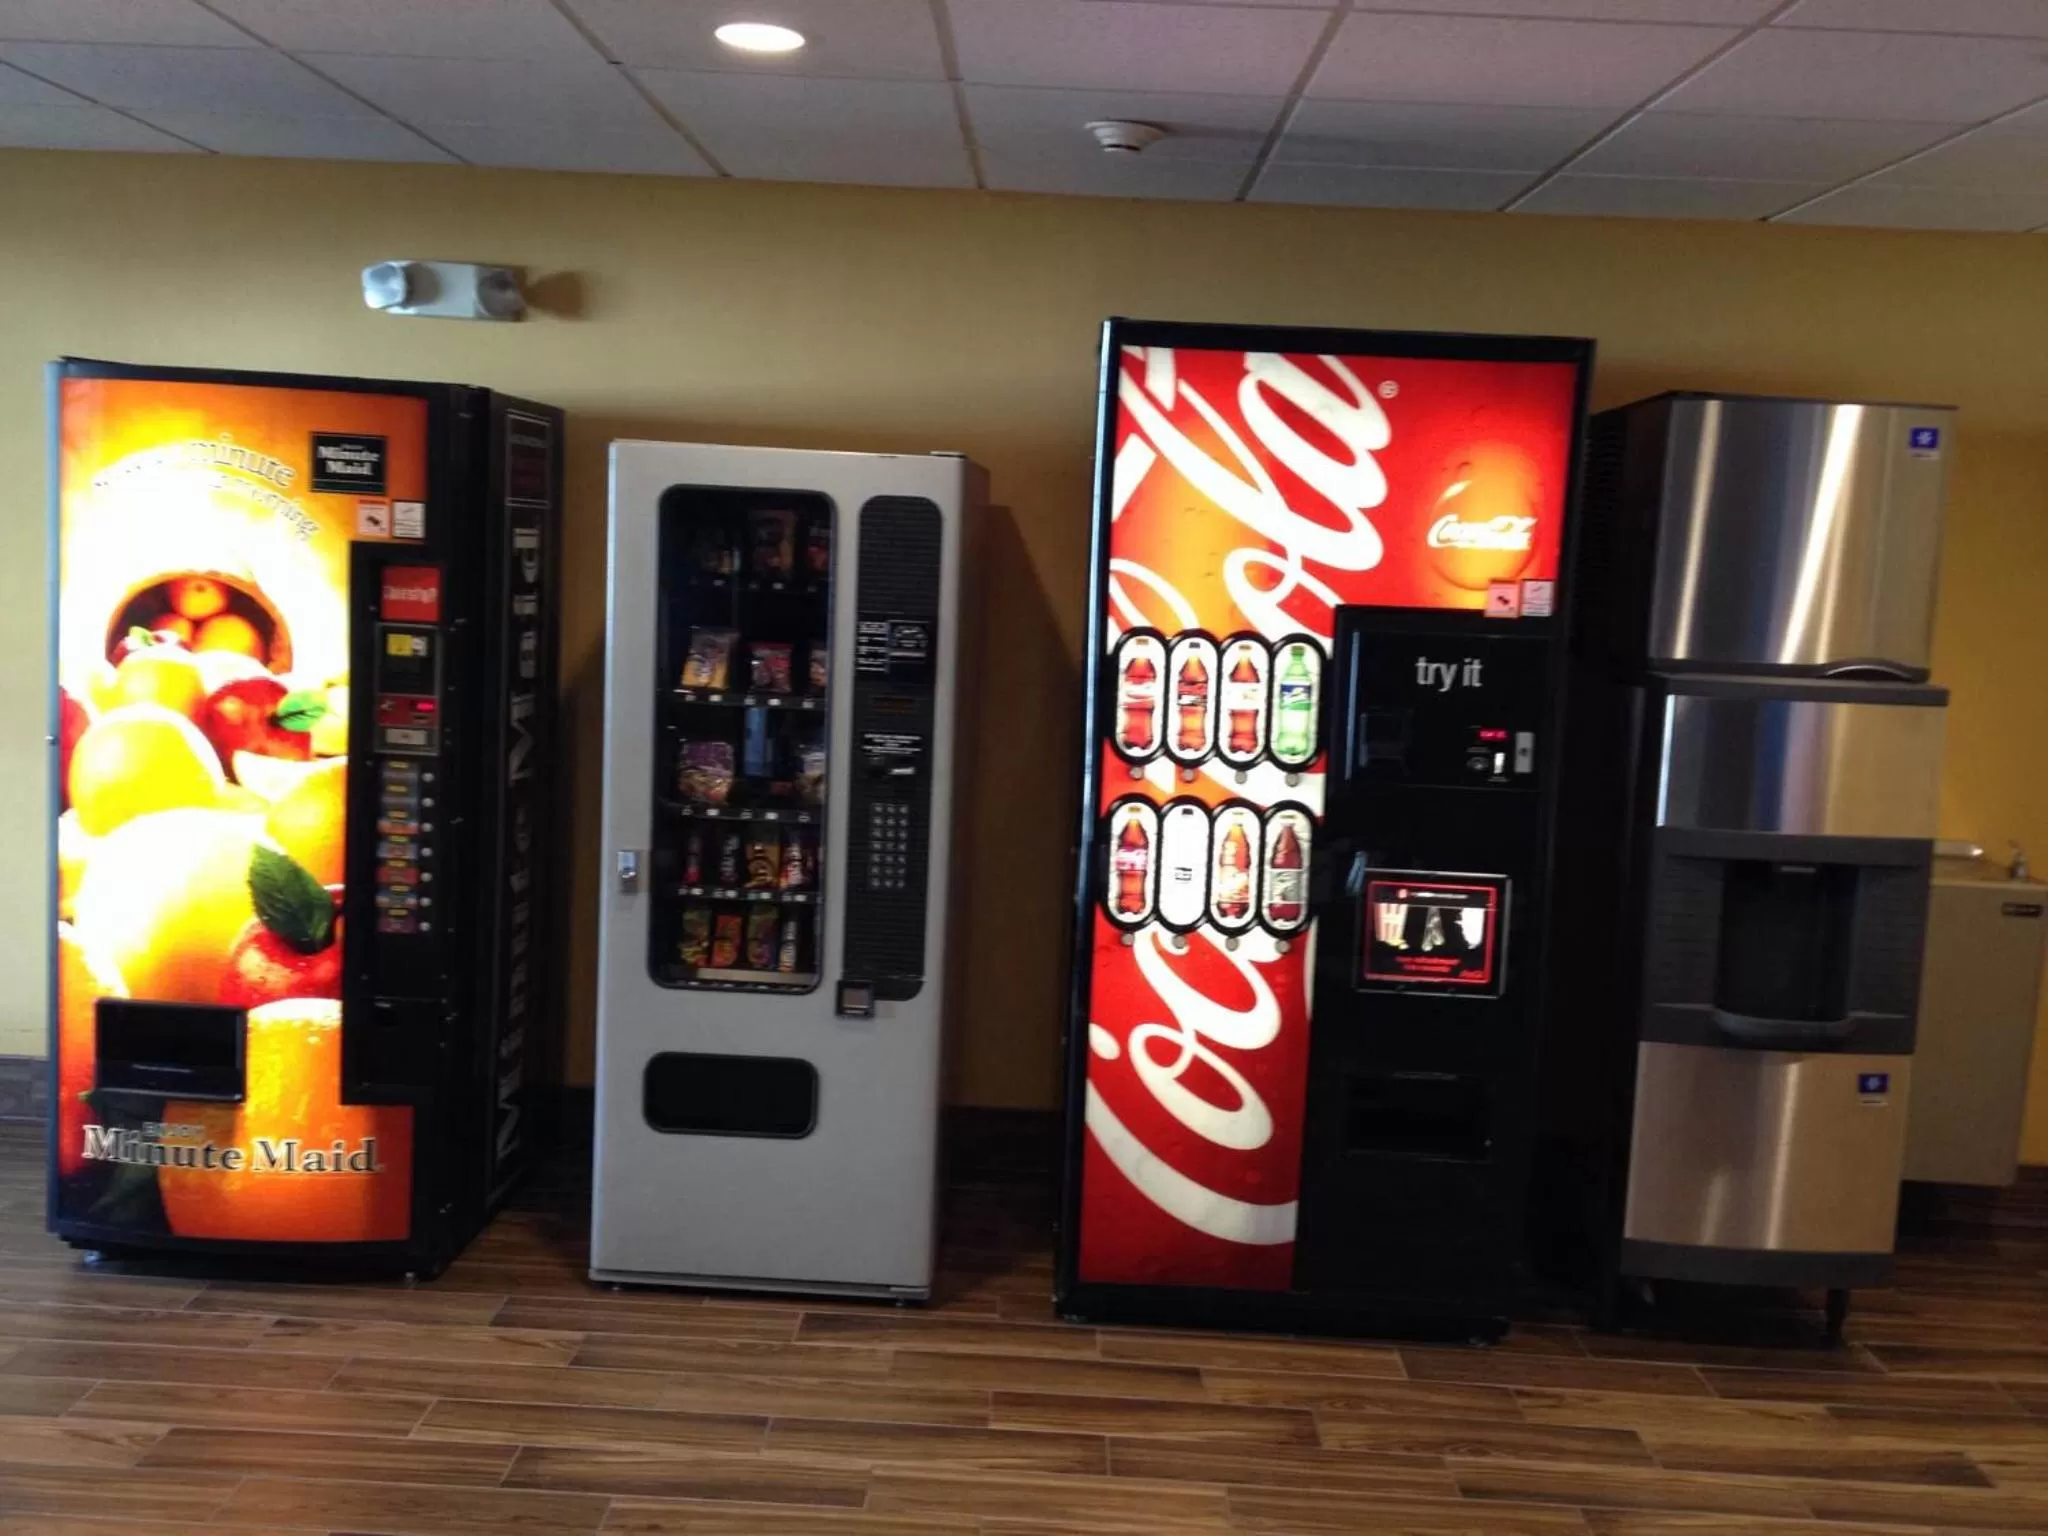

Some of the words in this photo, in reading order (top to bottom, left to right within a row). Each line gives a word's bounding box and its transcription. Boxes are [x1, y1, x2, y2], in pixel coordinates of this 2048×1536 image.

[1415, 656, 1458, 692] try
[1463, 658, 1483, 688] it
[81, 1123, 246, 1172] Minute
[251, 1136, 378, 1173] Maid
